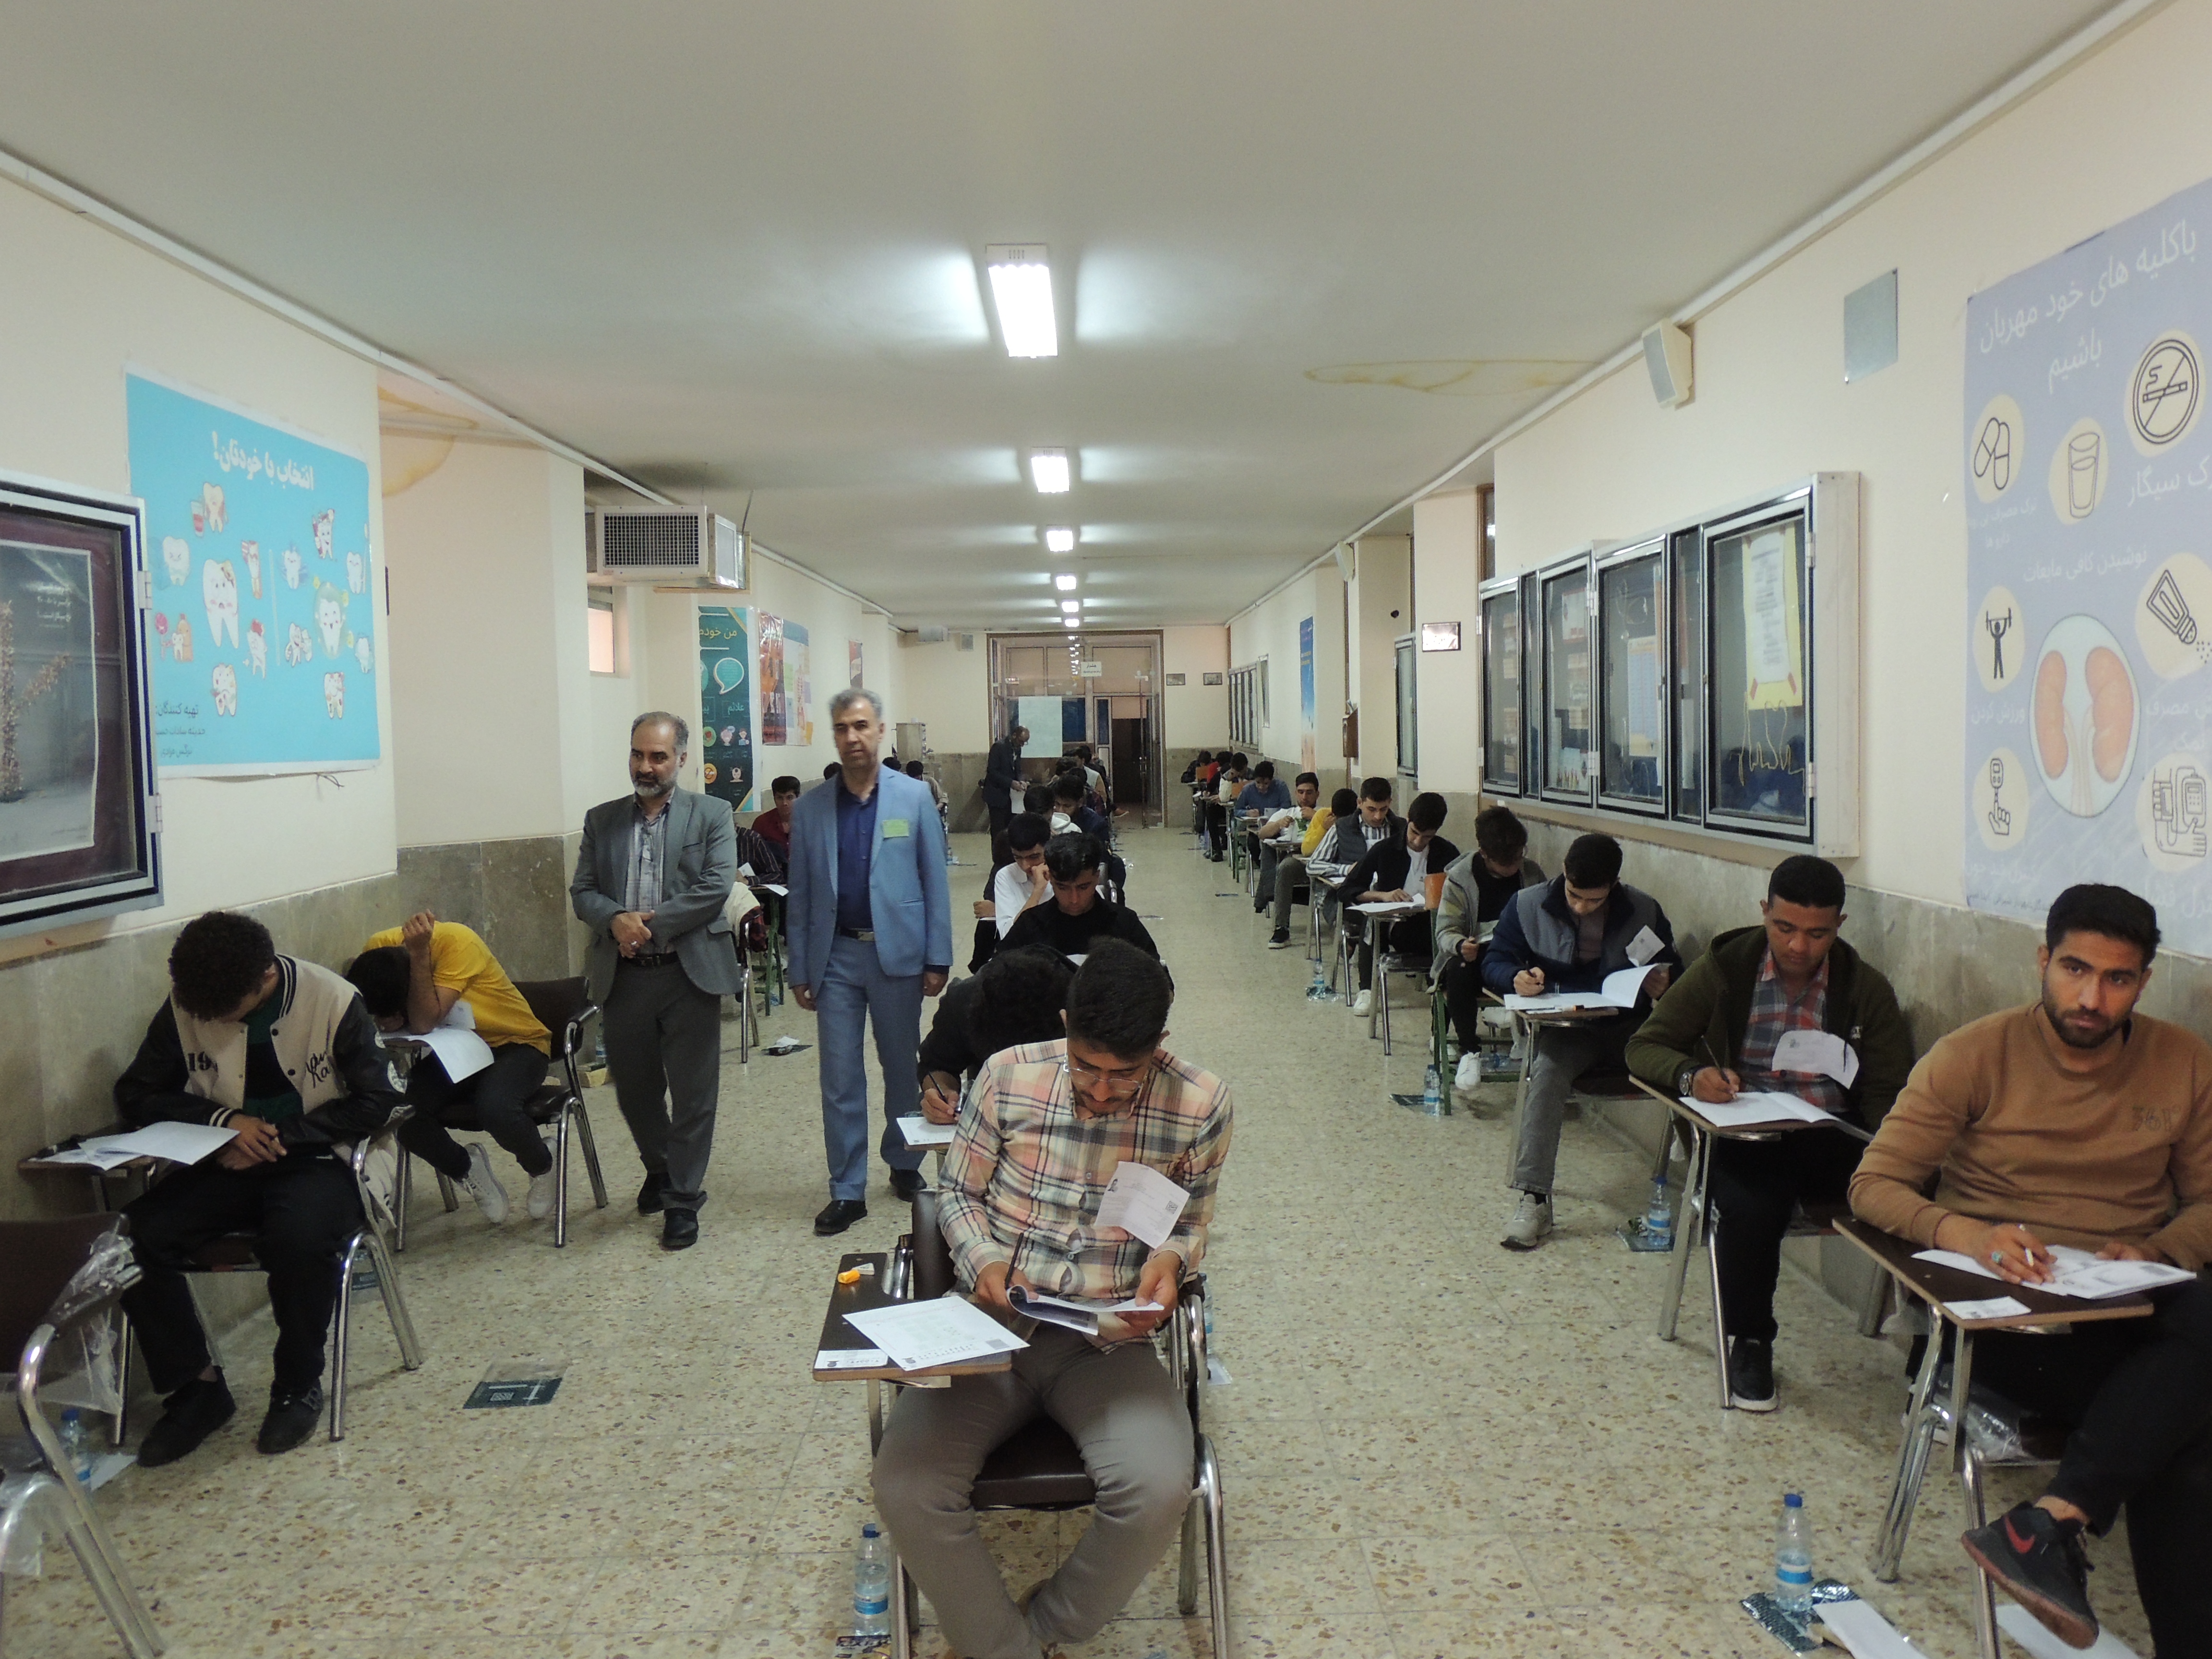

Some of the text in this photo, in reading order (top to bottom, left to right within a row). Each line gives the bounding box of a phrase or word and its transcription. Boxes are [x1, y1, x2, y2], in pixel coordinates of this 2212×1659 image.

[2046, 281, 2084, 323] خود
[2091, 256, 2129, 307] های
[1981, 308, 2038, 353] مهربان
[2049, 328, 2102, 395] باشیم
[264, 451, 275, 485] با
[276, 459, 314, 491] انتخاب
[2128, 464, 2180, 507] سیگار
[724, 628, 737, 639] من
[728, 703, 745, 715] علائم
